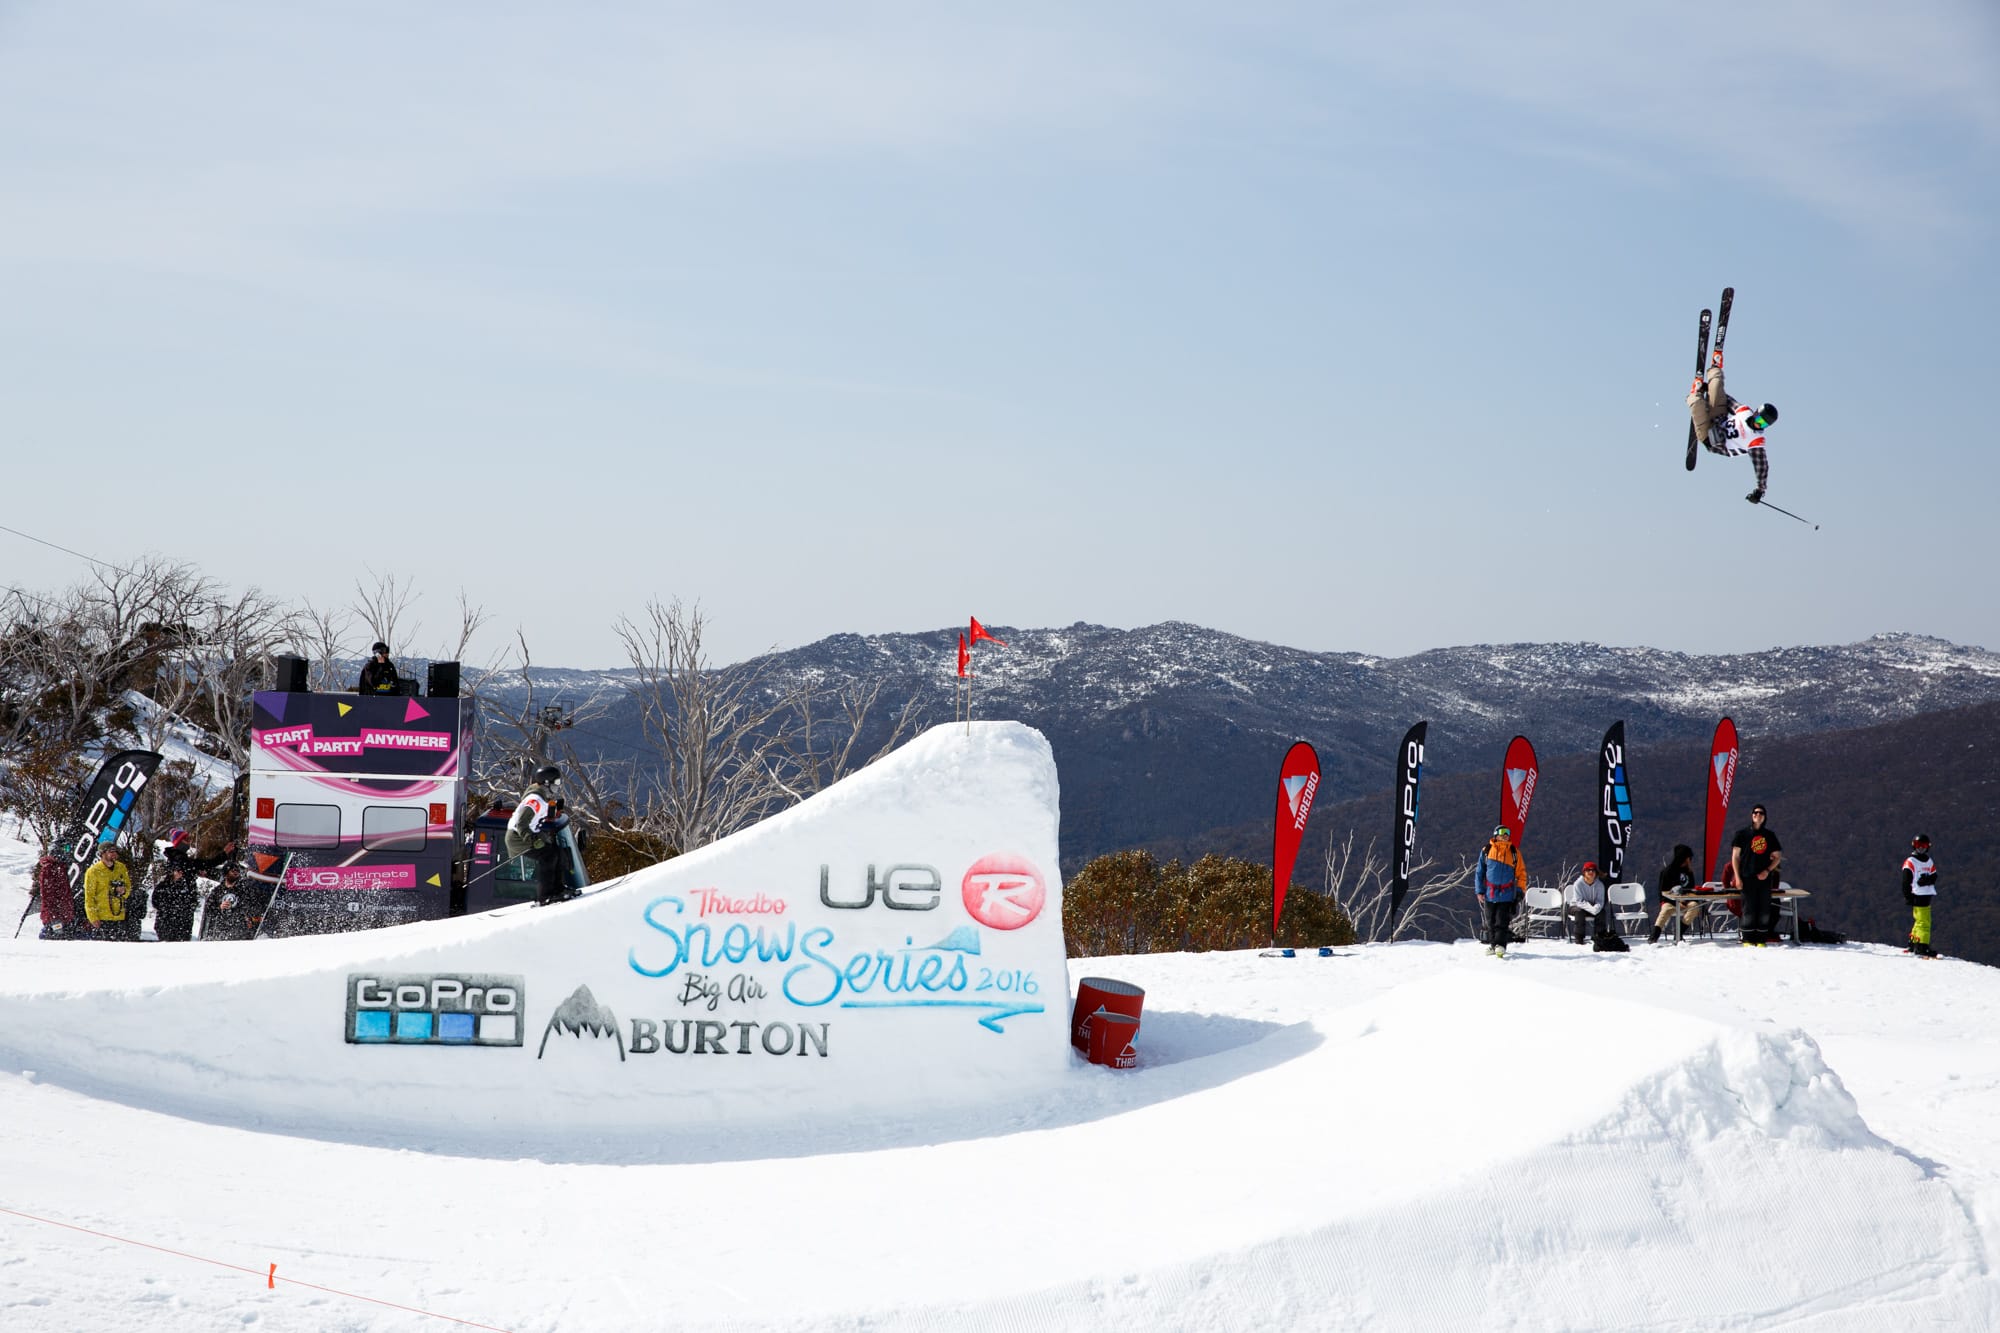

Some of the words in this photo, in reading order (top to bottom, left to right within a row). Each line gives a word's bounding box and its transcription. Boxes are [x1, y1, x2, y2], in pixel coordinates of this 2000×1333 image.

[263, 729, 311, 745] START
[300, 742, 310, 753] A
[314, 741, 362, 753] PARTY
[364, 733, 449, 748] ANYWHERE
[1294, 770, 1319, 831] THREDBO
[1517, 767, 1538, 824] THREDBO
[1722, 746, 1738, 809] THREDBO
[1401, 740, 1418, 880] GoPro
[1603, 741, 1624, 879] GoPro
[690, 888, 788, 918] Thredbo
[628, 895, 796, 978] Snow
[782, 926, 969, 1007] Series
[975, 967, 1039, 995] 2016
[356, 979, 516, 1012] GoPro
[677, 971, 723, 1011] Big
[728, 973, 768, 1001] Air
[629, 1018, 831, 1058] BURTON
